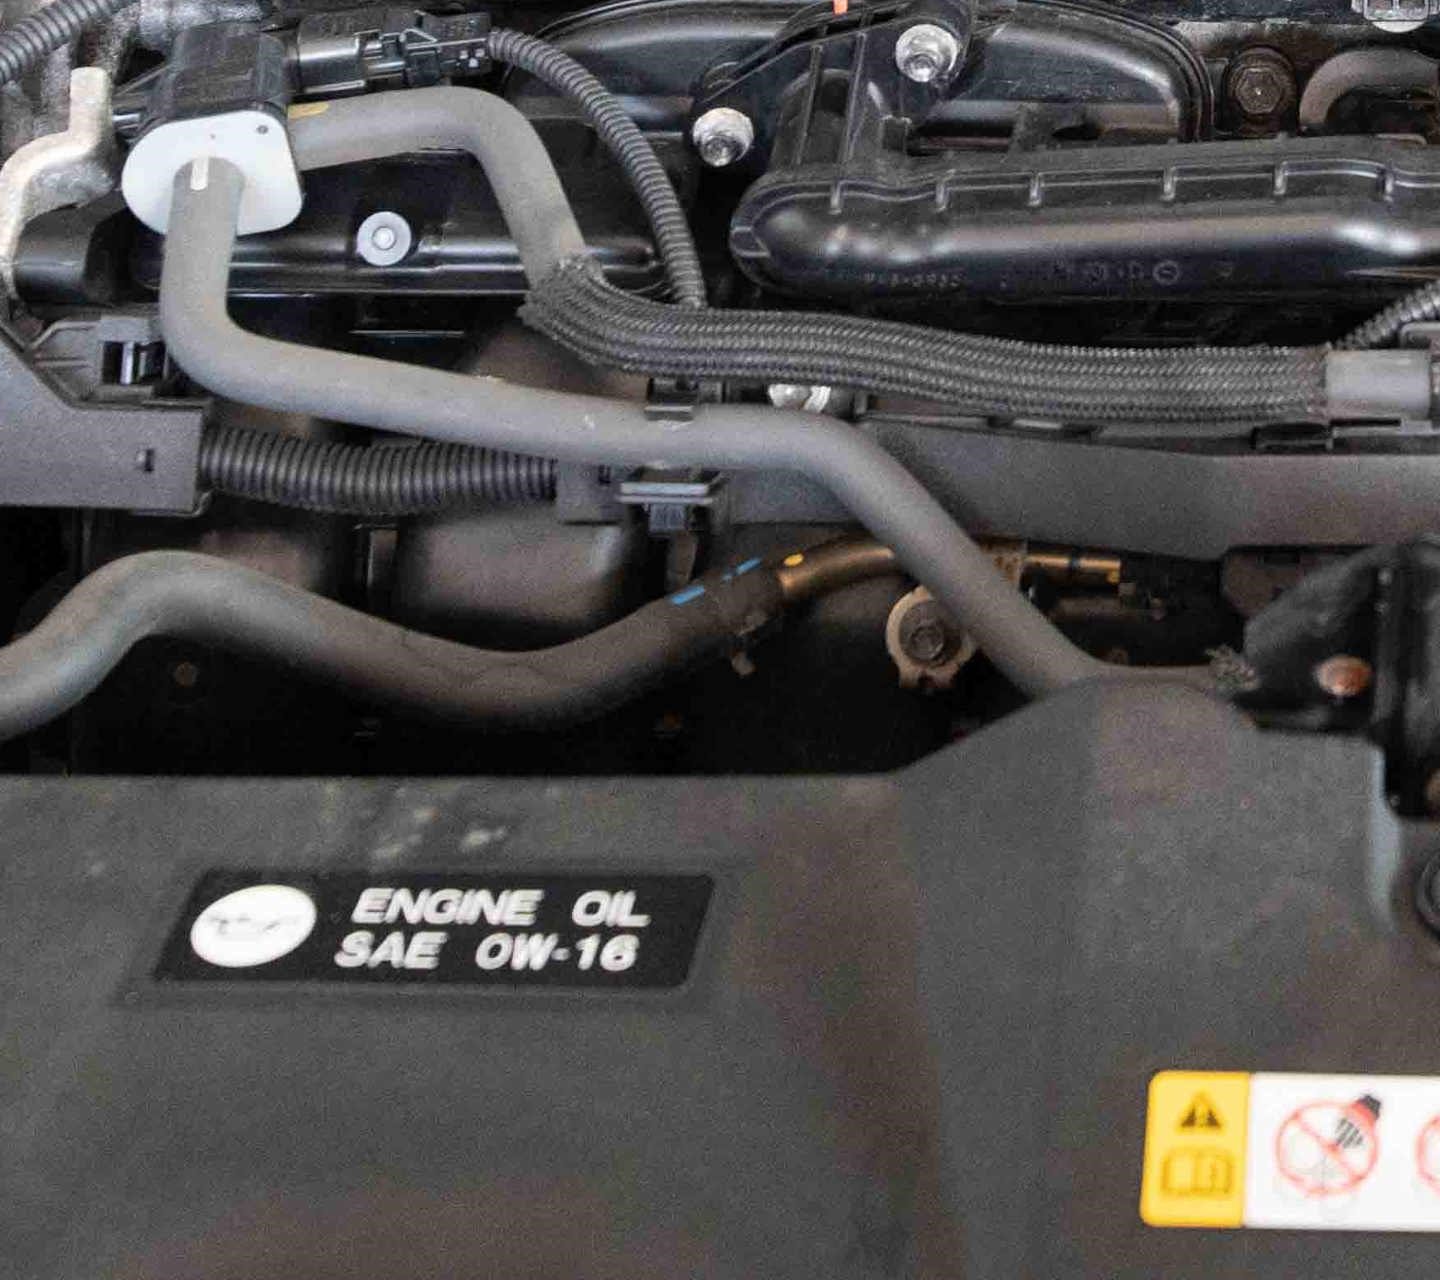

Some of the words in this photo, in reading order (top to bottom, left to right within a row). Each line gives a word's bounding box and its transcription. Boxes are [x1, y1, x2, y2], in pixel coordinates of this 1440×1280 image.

[350, 887, 544, 926] ENGINE
[571, 889, 651, 928] OIL
[333, 930, 449, 970] SAE
[474, 933, 641, 972] 0W-16
